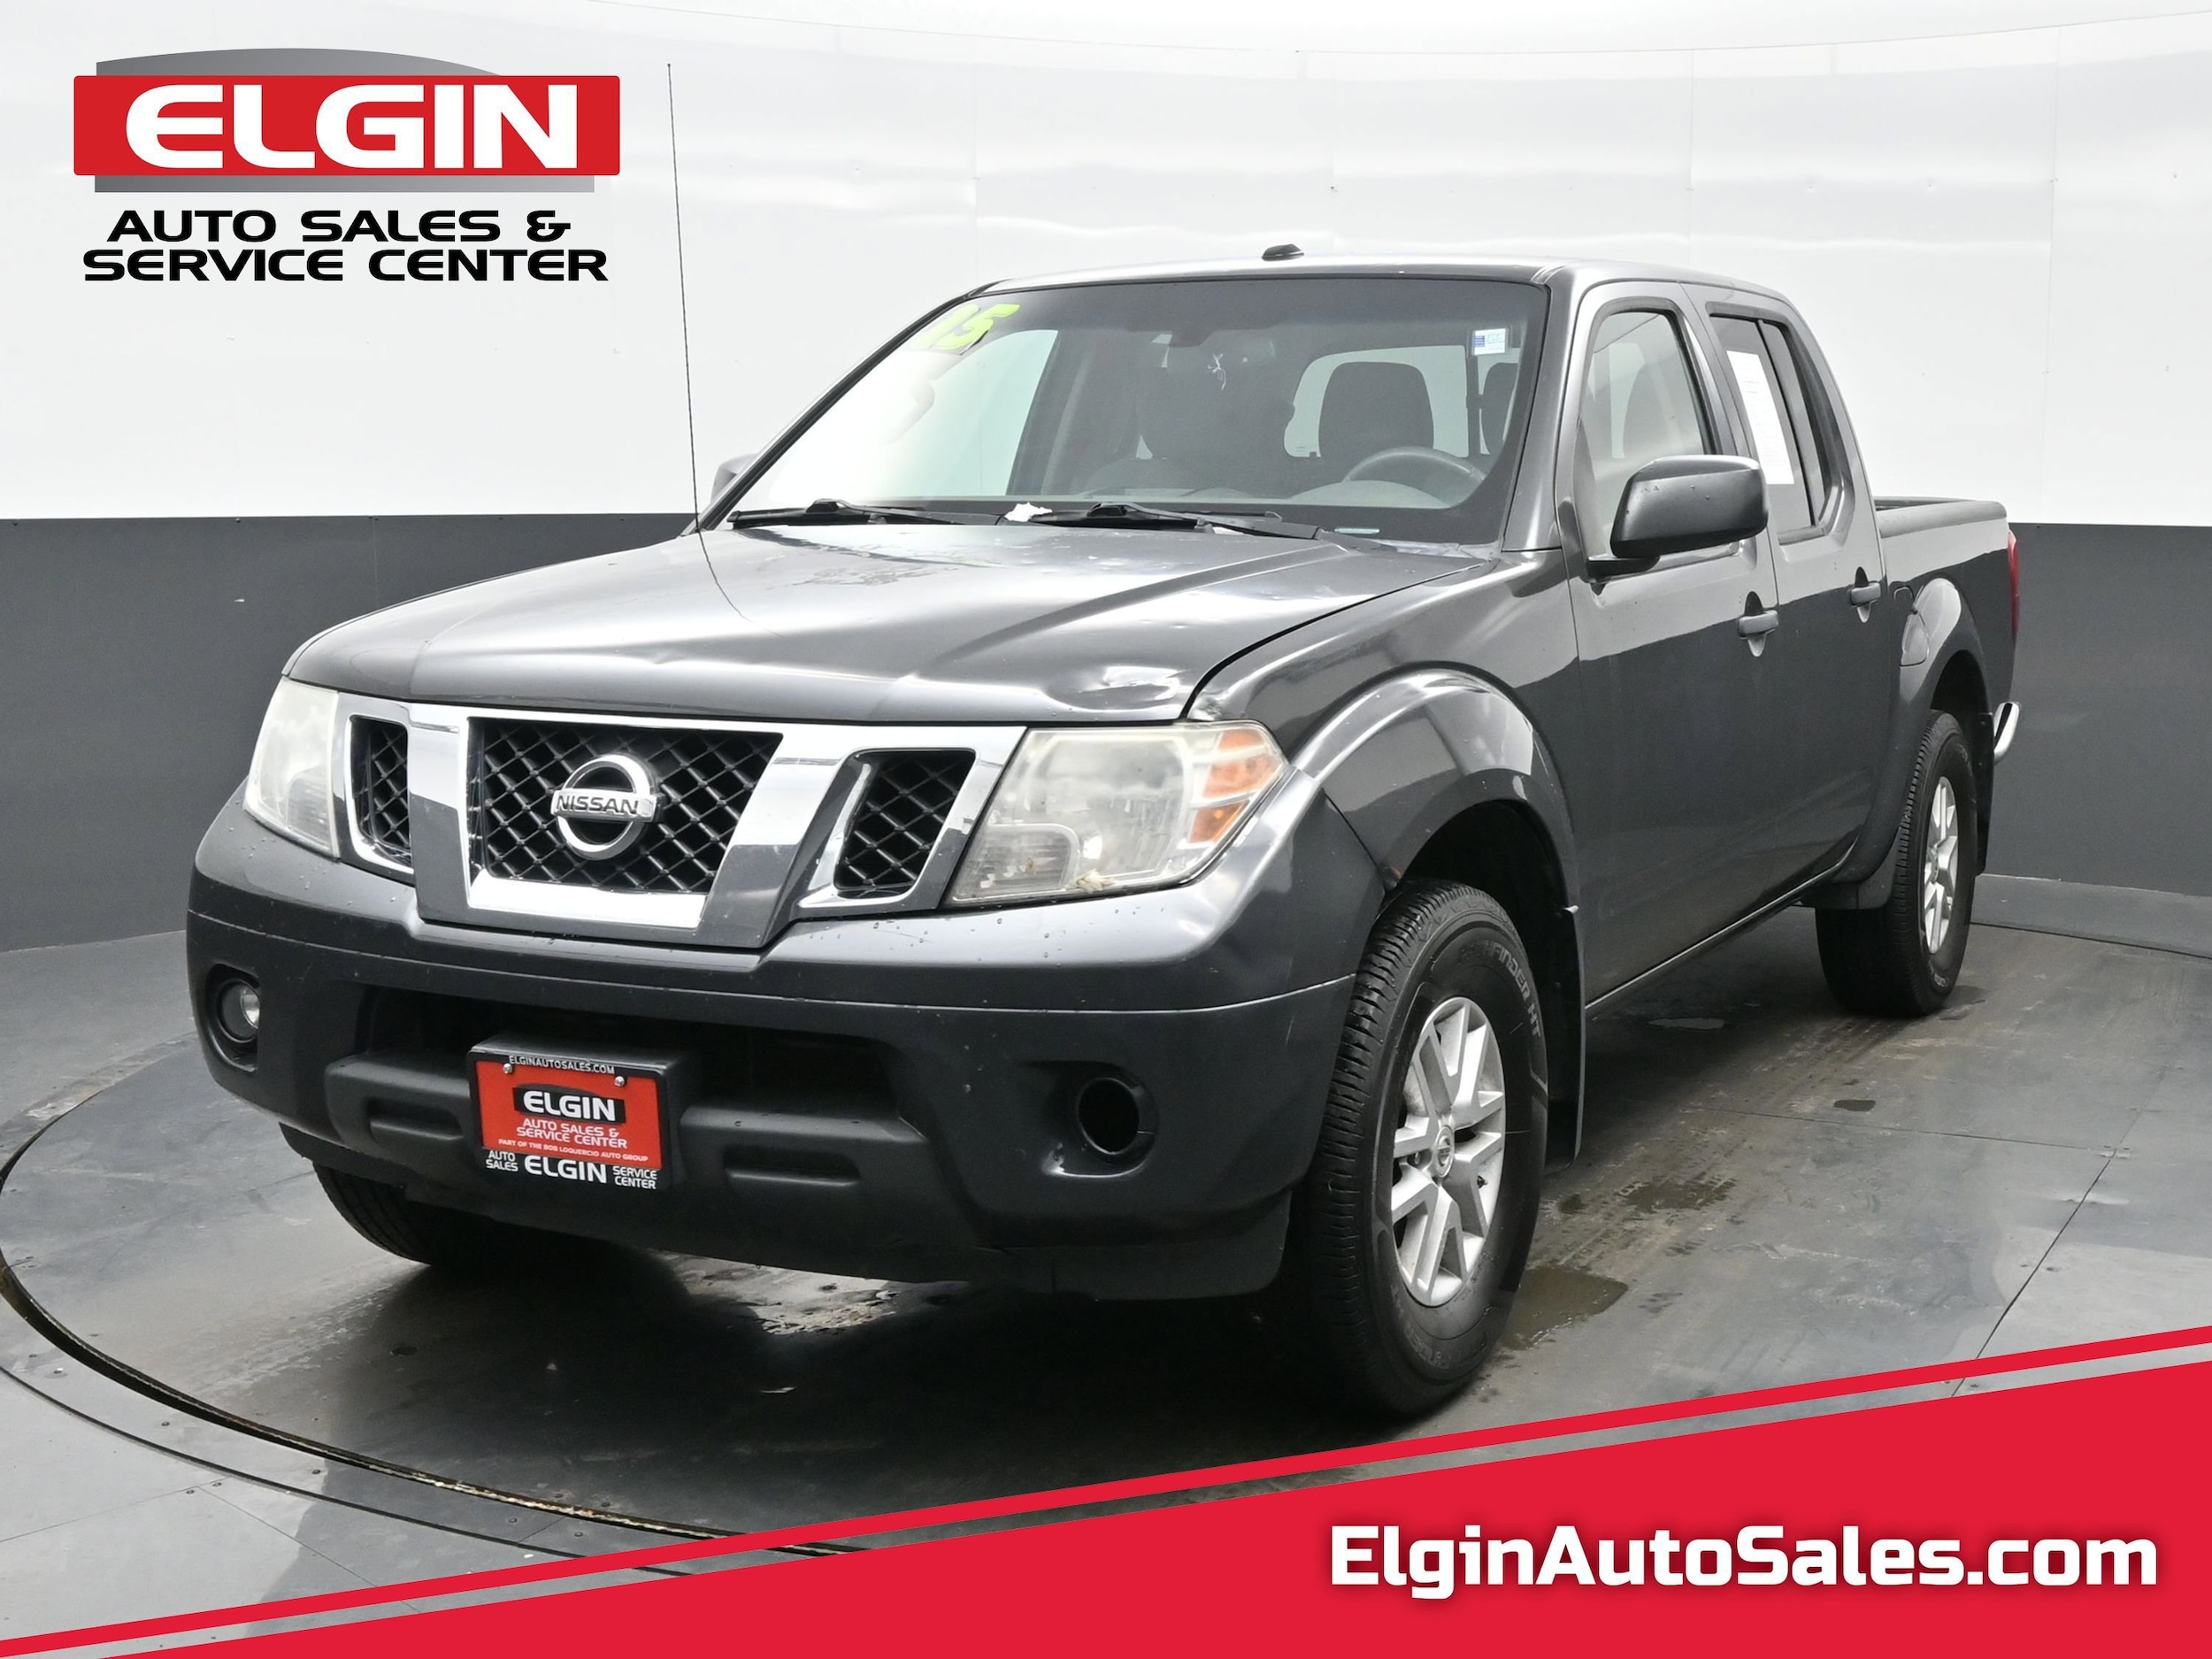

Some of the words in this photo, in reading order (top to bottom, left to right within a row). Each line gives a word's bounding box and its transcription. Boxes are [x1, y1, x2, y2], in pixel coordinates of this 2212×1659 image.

[556, 795, 639, 815] NISSAN
[508, 1055, 616, 1075] ELGINAUTOSALES.COM
[523, 1090, 616, 1122] ELGIN
[516, 1127, 571, 1142] SERVICE
[574, 1135, 628, 1149] CENTER
[522, 1118, 557, 1132] AUTO
[560, 1123, 605, 1138] SALES
[608, 1127, 620, 1138] &
[488, 1149, 516, 1163] AUTO
[497, 1138, 517, 1147] PART
[559, 1146, 600, 1157] LOQUERCIO
[601, 1151, 622, 1160] AUTO
[622, 1154, 649, 1163] GROUP
[486, 1159, 518, 1172] SALES
[524, 1155, 608, 1184] ELGIN
[612, 1165, 658, 1180] SERVICE
[614, 1175, 657, 1190] CENTER
